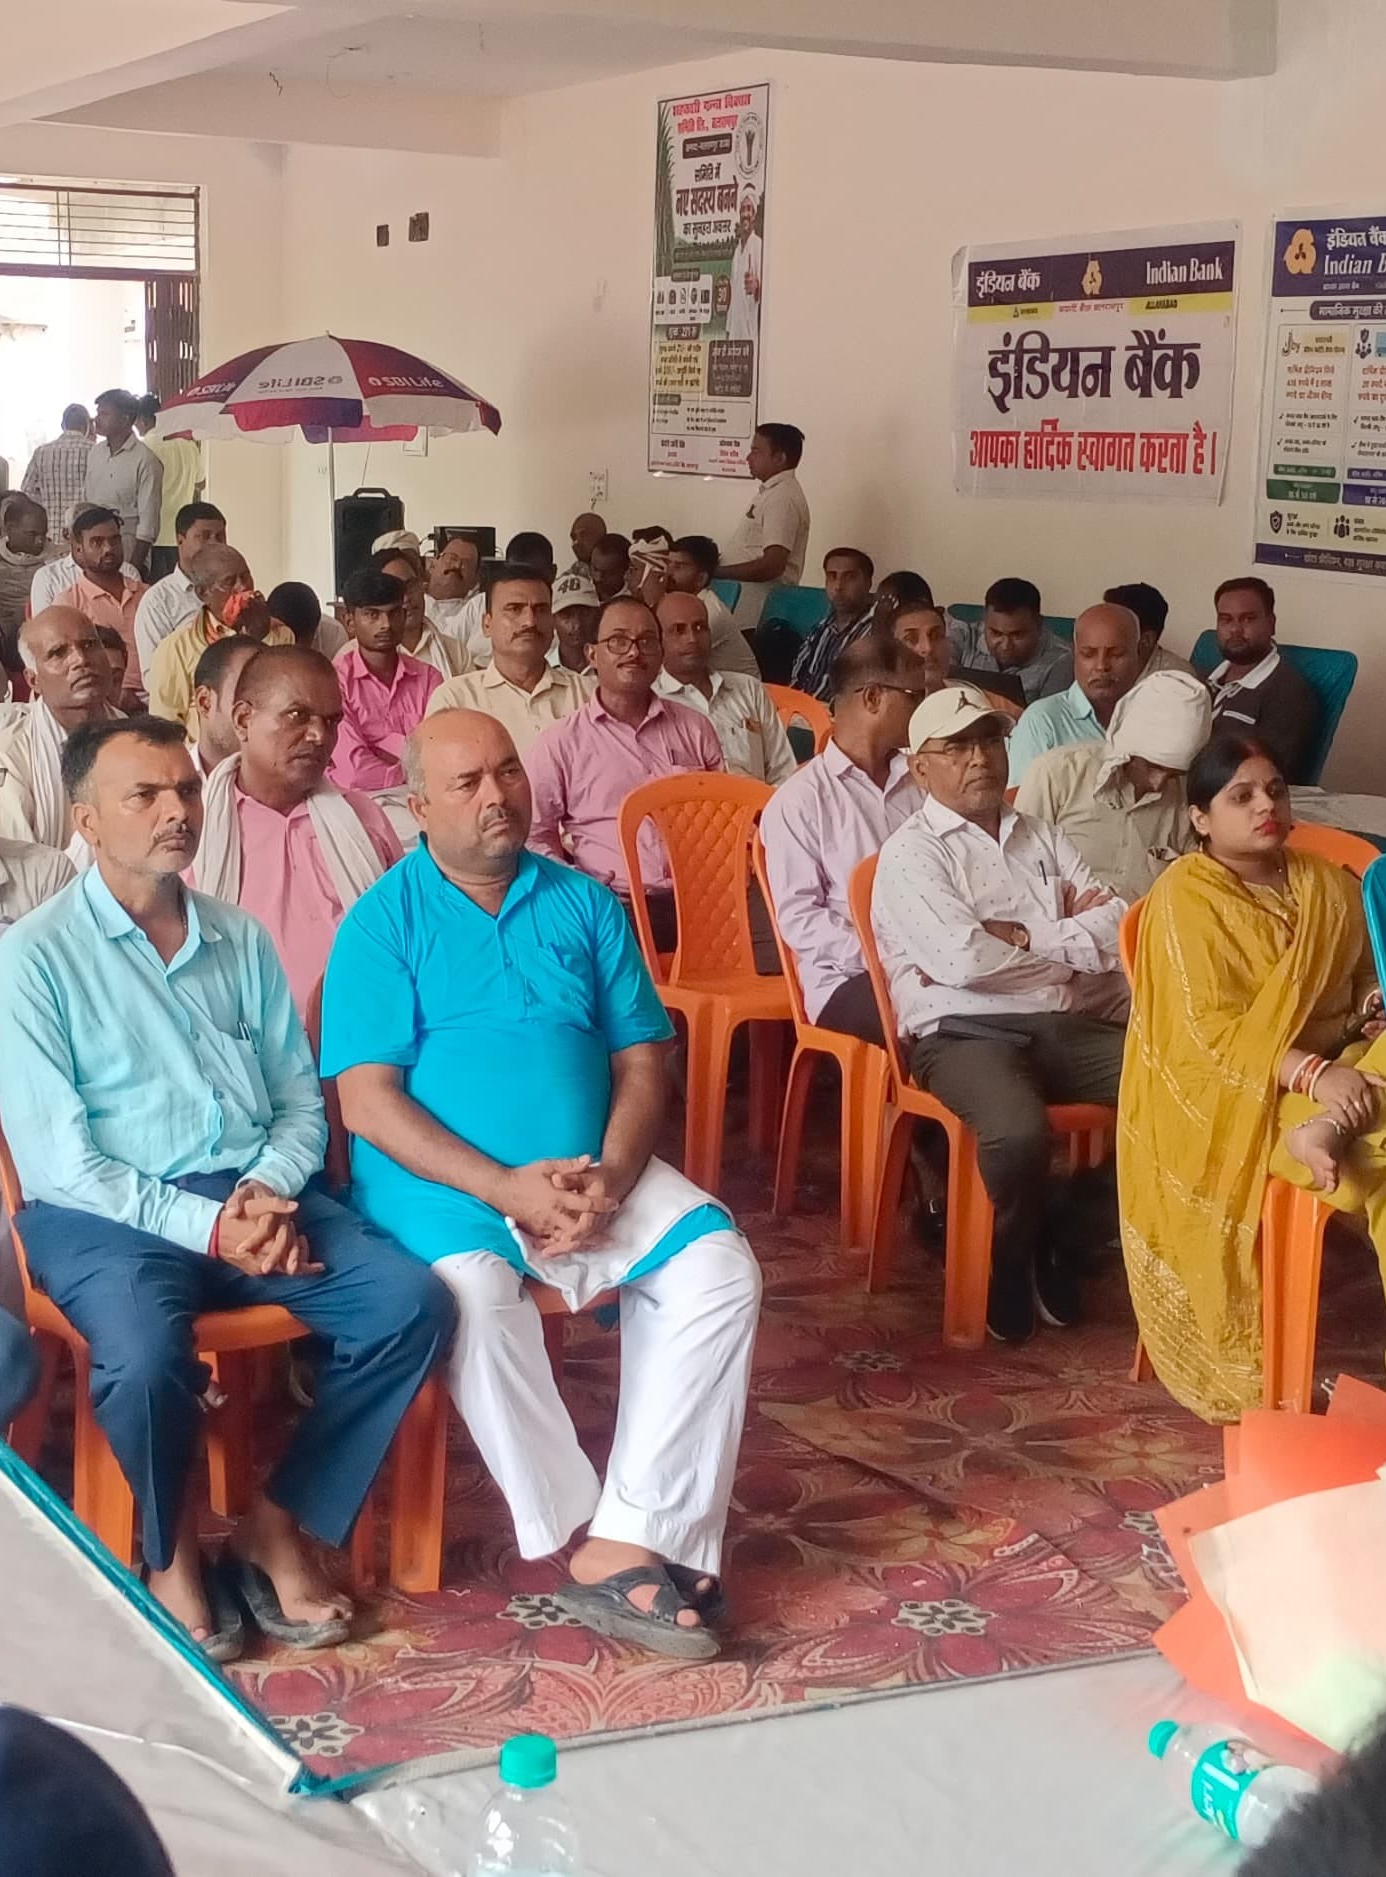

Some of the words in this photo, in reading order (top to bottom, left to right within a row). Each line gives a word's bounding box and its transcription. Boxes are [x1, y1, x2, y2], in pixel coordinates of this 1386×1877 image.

[676, 188, 690, 217] नए
[690, 186, 716, 216] सदस्य
[717, 174, 739, 213] बनने
[1326, 227, 1367, 251] इंडियन
[1146, 258, 1188, 285] Indian
[1189, 256, 1224, 282] Bank
[1324, 254, 1372, 275] Indian
[975, 269, 1016, 299] इंडियन
[1017, 267, 1042, 291] बैंक
[987, 330, 1116, 414] इंडियन
[1124, 328, 1201, 399] बैंक
[969, 429, 1022, 469] आपका
[1023, 418, 1074, 471] हार्दिक
[1077, 431, 1136, 473] स्वागत
[1139, 432, 1189, 475] करता
